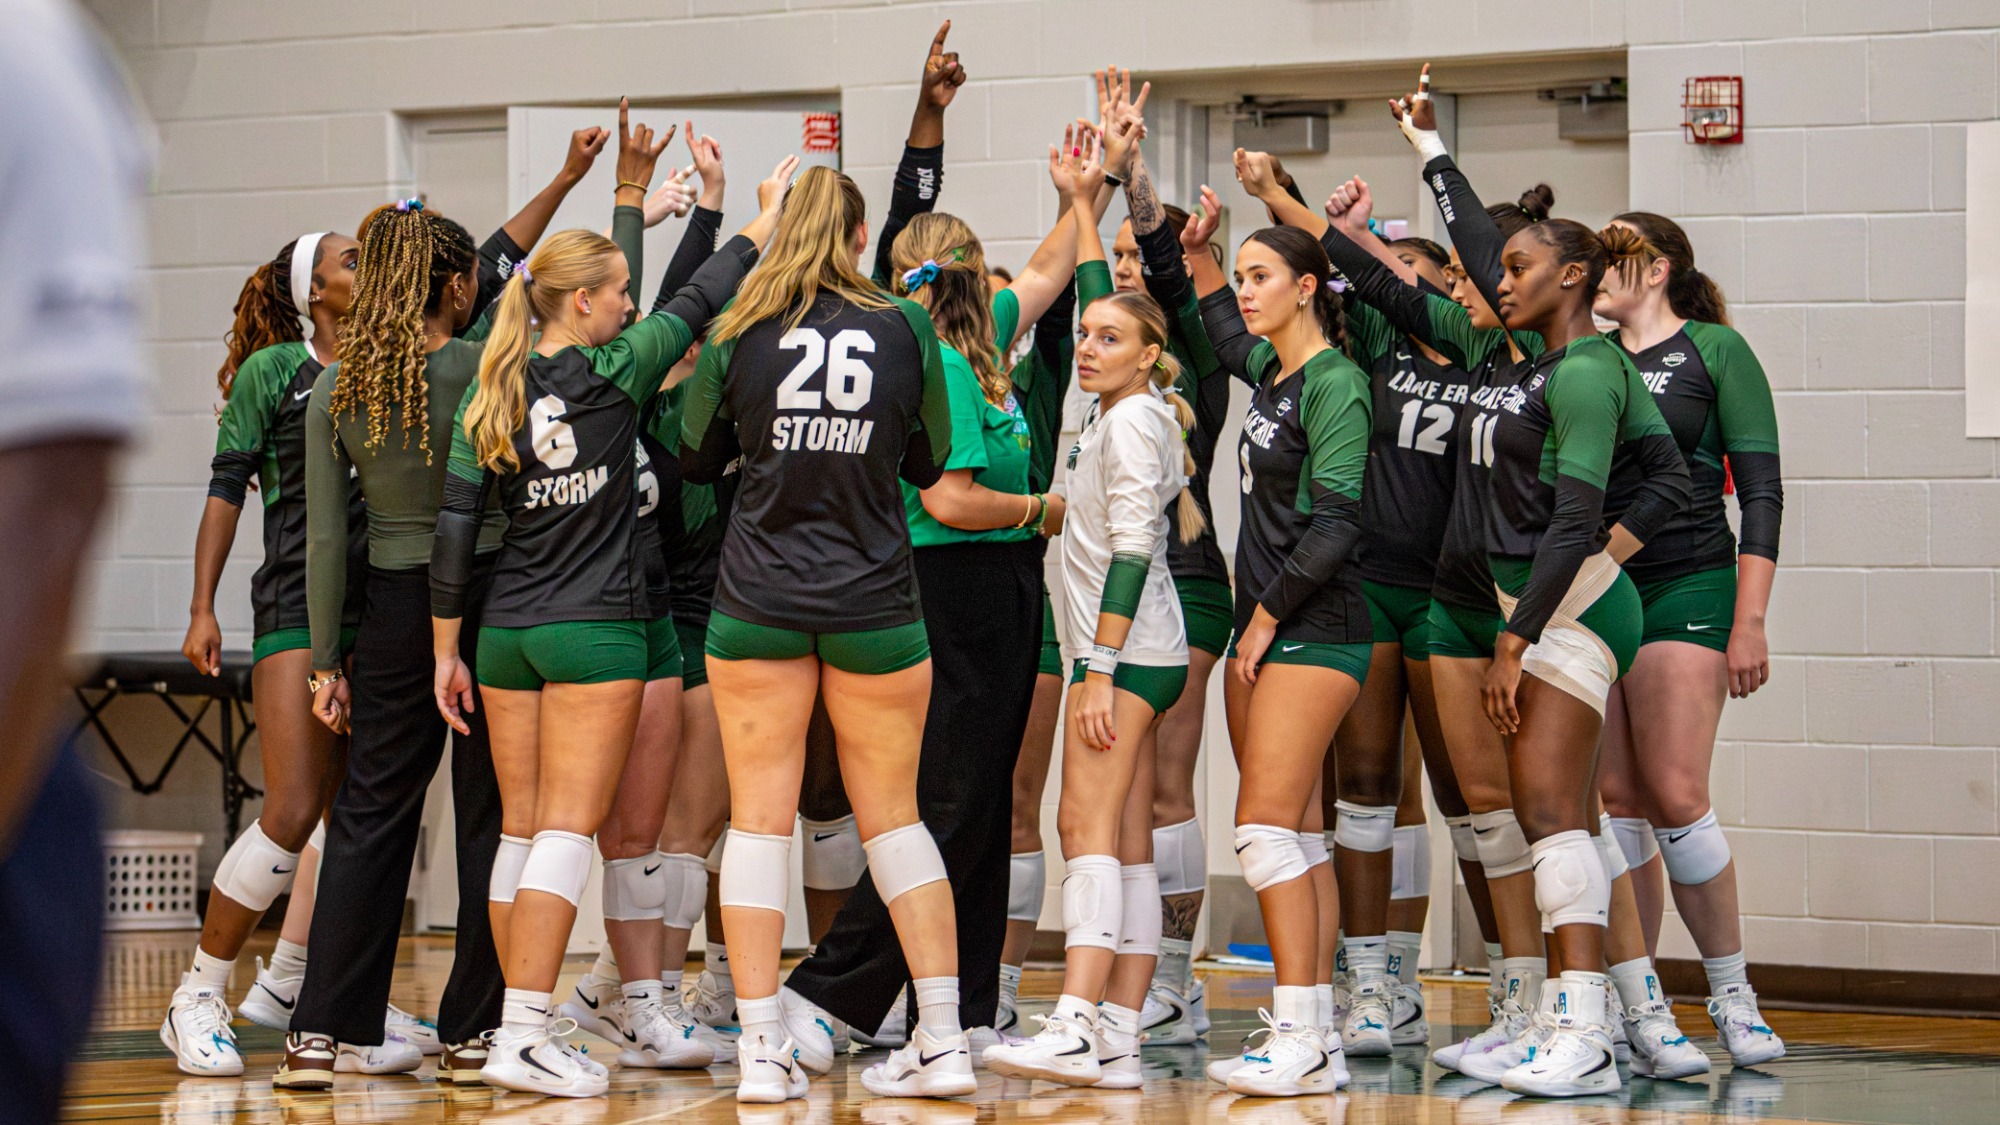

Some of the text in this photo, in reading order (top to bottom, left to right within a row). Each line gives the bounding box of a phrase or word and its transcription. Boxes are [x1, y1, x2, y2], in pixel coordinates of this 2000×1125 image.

[1438, 193, 1456, 225] TEAM
[776, 327, 876, 412] 26
[1639, 371, 1674, 395] RIE
[1440, 383, 1469, 405] ER
[529, 393, 579, 471] 6
[772, 415, 875, 455] STORM
[1397, 398, 1456, 456] 12
[523, 464, 609, 510] STORM
